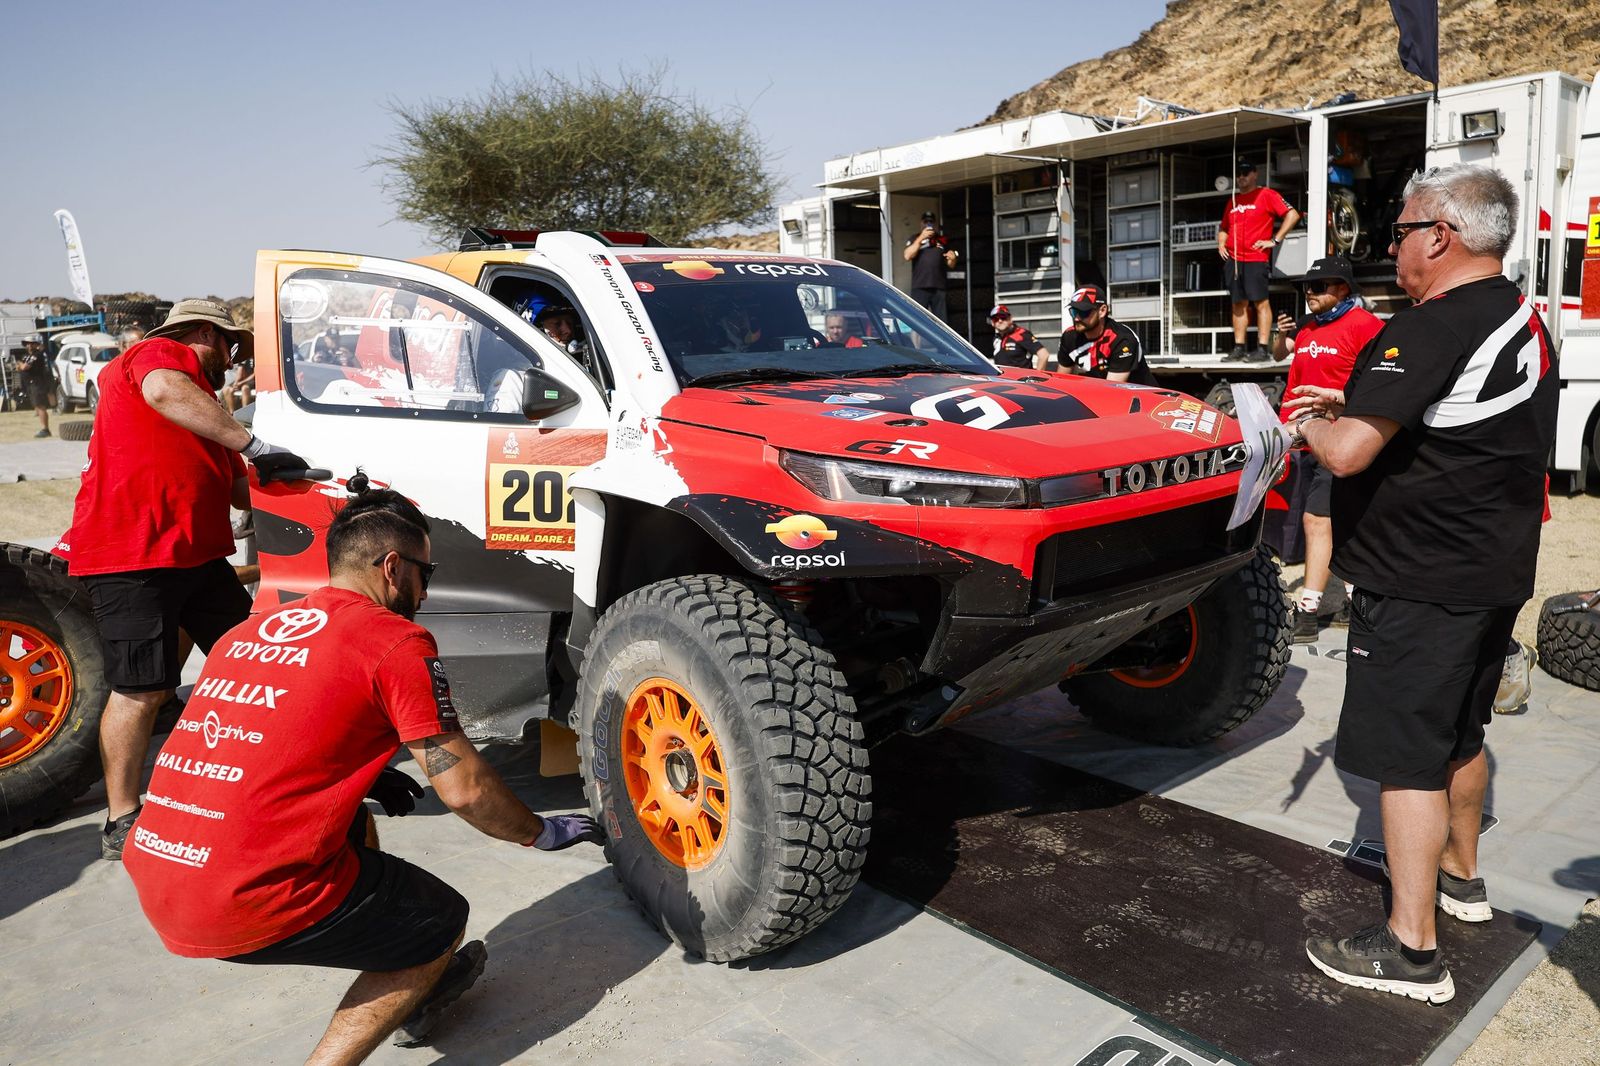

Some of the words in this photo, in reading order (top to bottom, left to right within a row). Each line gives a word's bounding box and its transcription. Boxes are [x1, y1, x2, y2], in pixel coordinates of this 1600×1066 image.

[735, 263, 829, 278] repsol
[601, 267, 625, 298] TOYOTA
[621, 300, 645, 335] GAZOO
[641, 336, 663, 372] Racing
[845, 439, 938, 460] GR
[1105, 450, 1226, 497] TOYOTA
[502, 469, 576, 523] 20
[491, 533, 532, 543] DREAM.
[534, 534, 566, 544] DARE.
[771, 551, 845, 570] repsol
[225, 641, 310, 667] TOYOTA
[195, 677, 289, 709] HILUX
[156, 752, 244, 783] HALLSPEED
[134, 826, 210, 863] BFGoodrich
